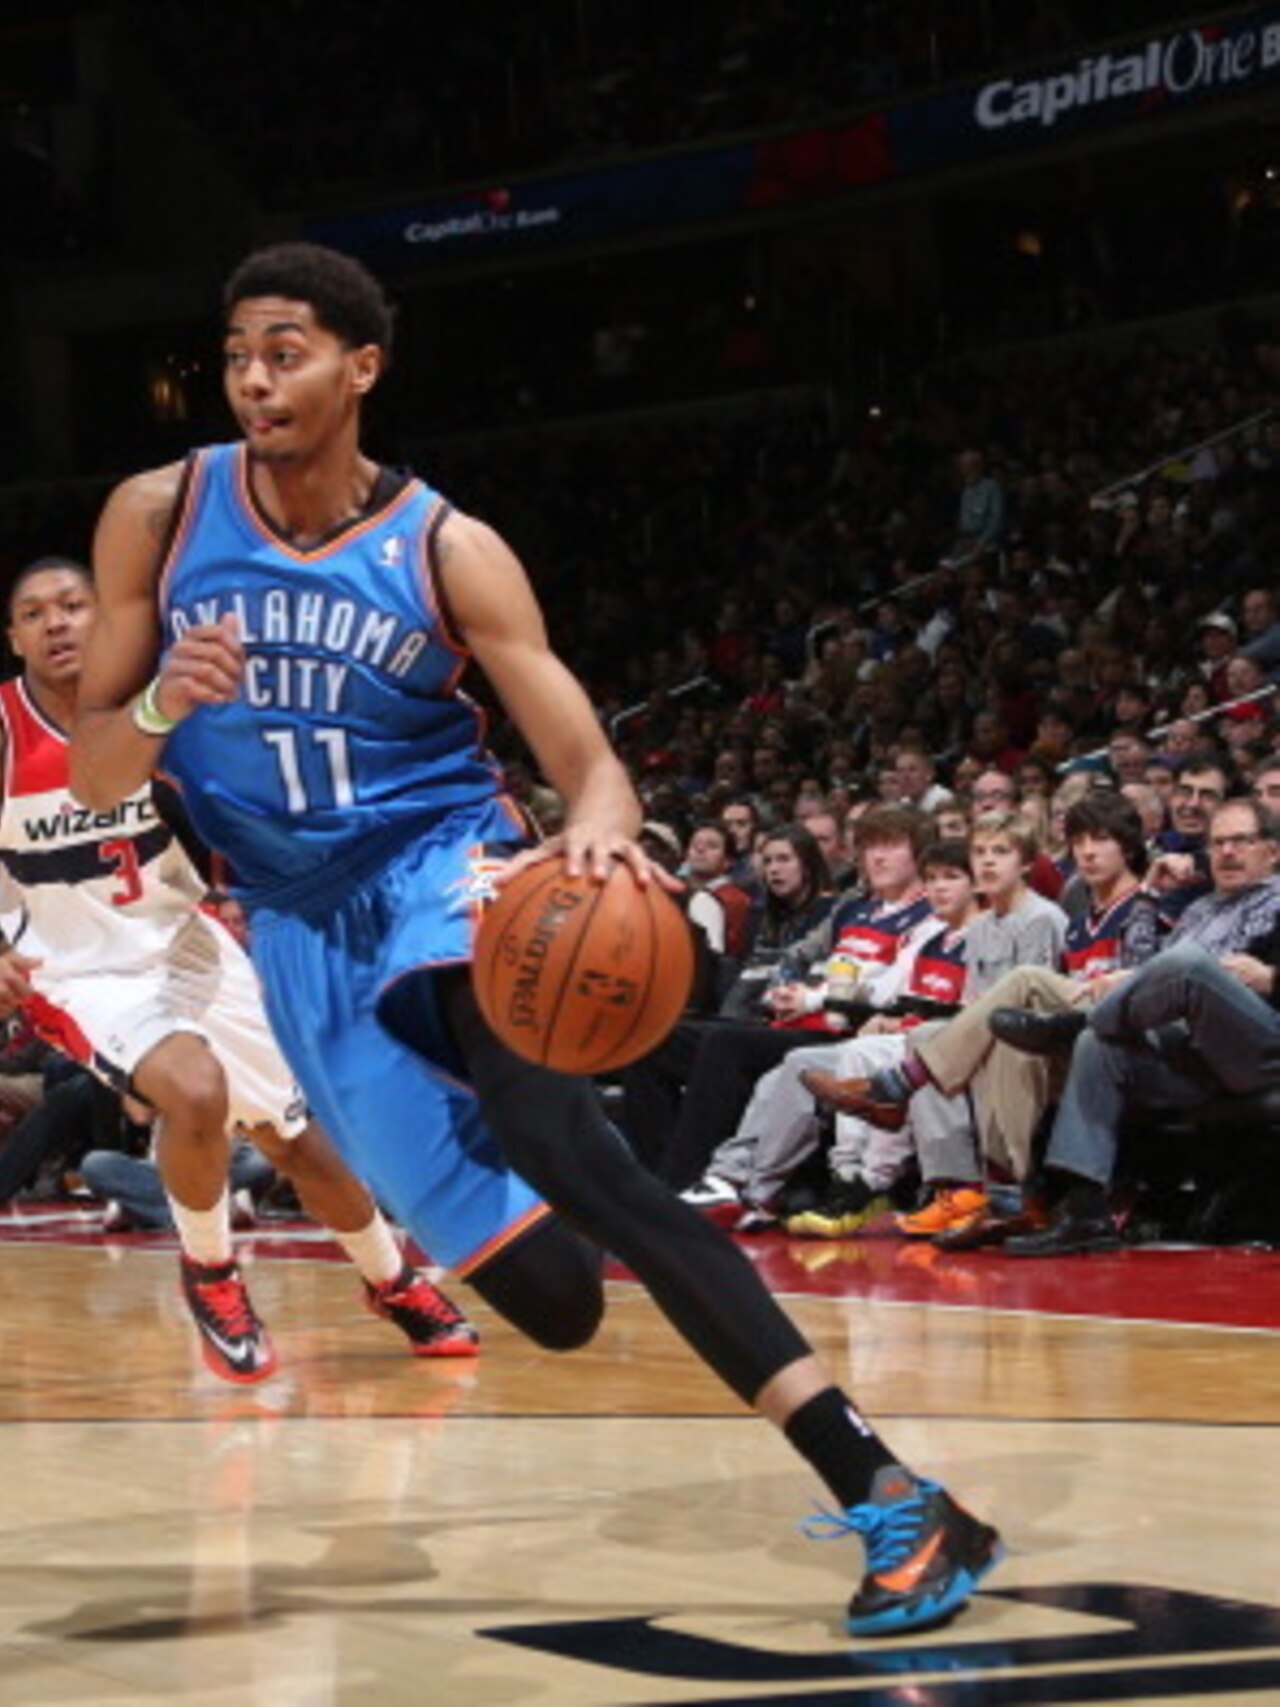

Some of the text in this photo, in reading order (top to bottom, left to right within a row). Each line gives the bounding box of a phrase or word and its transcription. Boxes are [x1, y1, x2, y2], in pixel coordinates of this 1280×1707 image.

[244, 656, 349, 713] CITY
[263, 727, 355, 814] 11
[98, 838, 143, 906] 3
